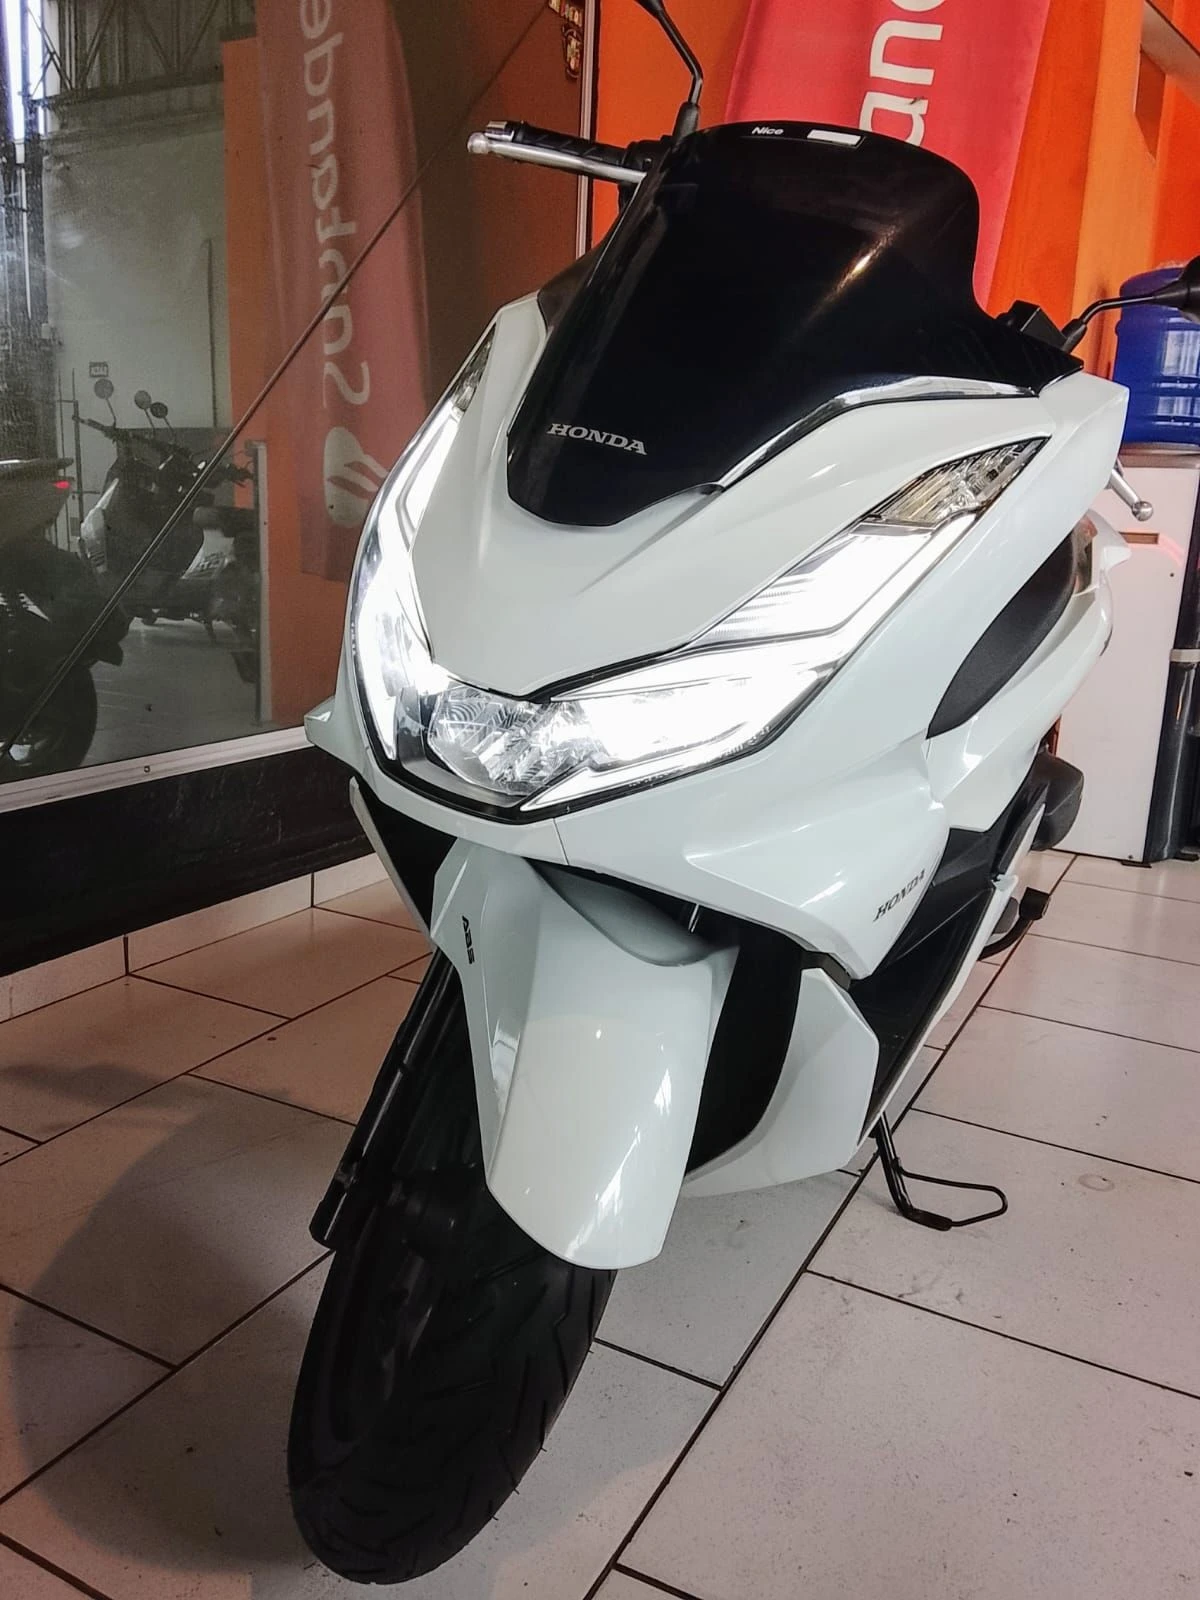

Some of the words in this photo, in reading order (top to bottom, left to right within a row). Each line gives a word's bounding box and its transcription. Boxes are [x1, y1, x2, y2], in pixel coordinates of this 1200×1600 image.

[751, 126, 785, 135] Nice
[546, 423, 648, 455] HONDA
[872, 868, 925, 922] HONDA
[462, 915, 475, 964] ABS
